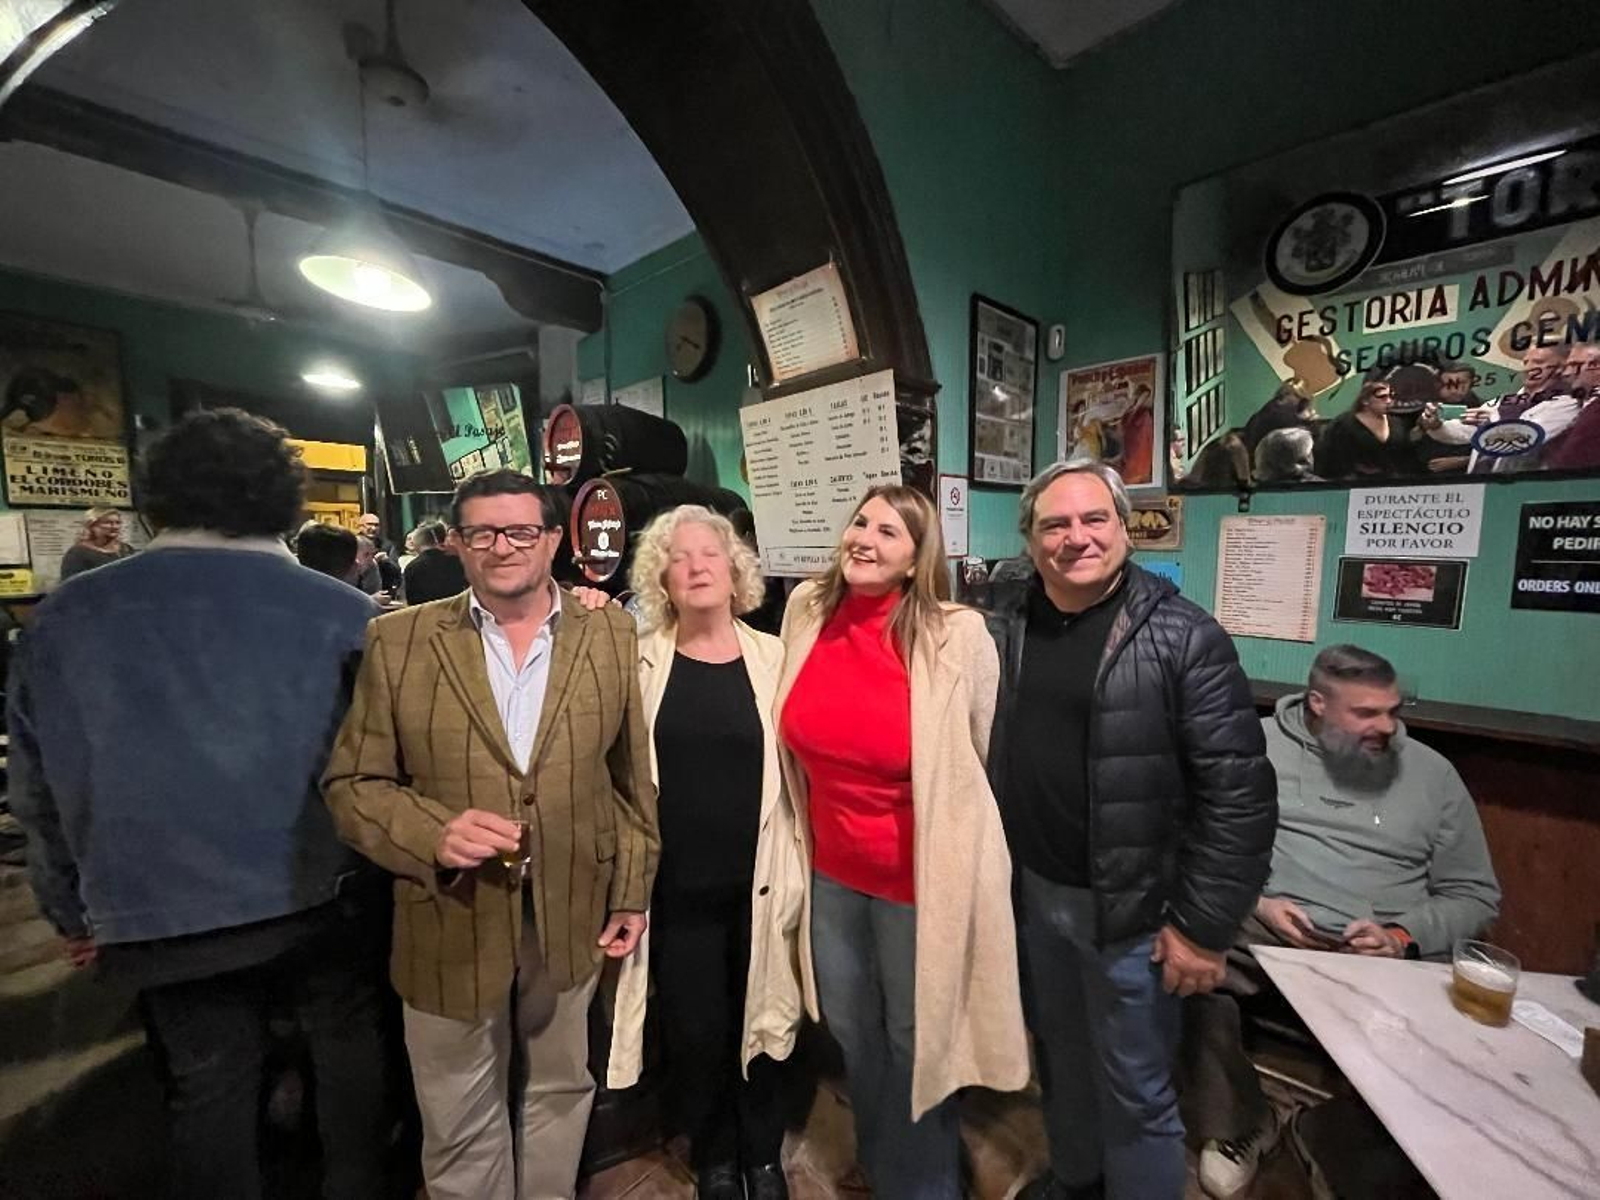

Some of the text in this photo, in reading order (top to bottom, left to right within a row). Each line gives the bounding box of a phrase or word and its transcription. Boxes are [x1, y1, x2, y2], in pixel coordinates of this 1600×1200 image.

[1276, 284, 1448, 345] GESTORIA
[1335, 326, 1491, 376] SEGUROS
[1364, 492, 1464, 505] DURANTE EL
[1357, 507, 1471, 520] ESPECTÁCULO
[1359, 521, 1464, 536] SILENCIO
[1529, 516, 1554, 529] NO
[1556, 515, 1593, 529] HAY
[1517, 579, 1571, 593] ORDERS
